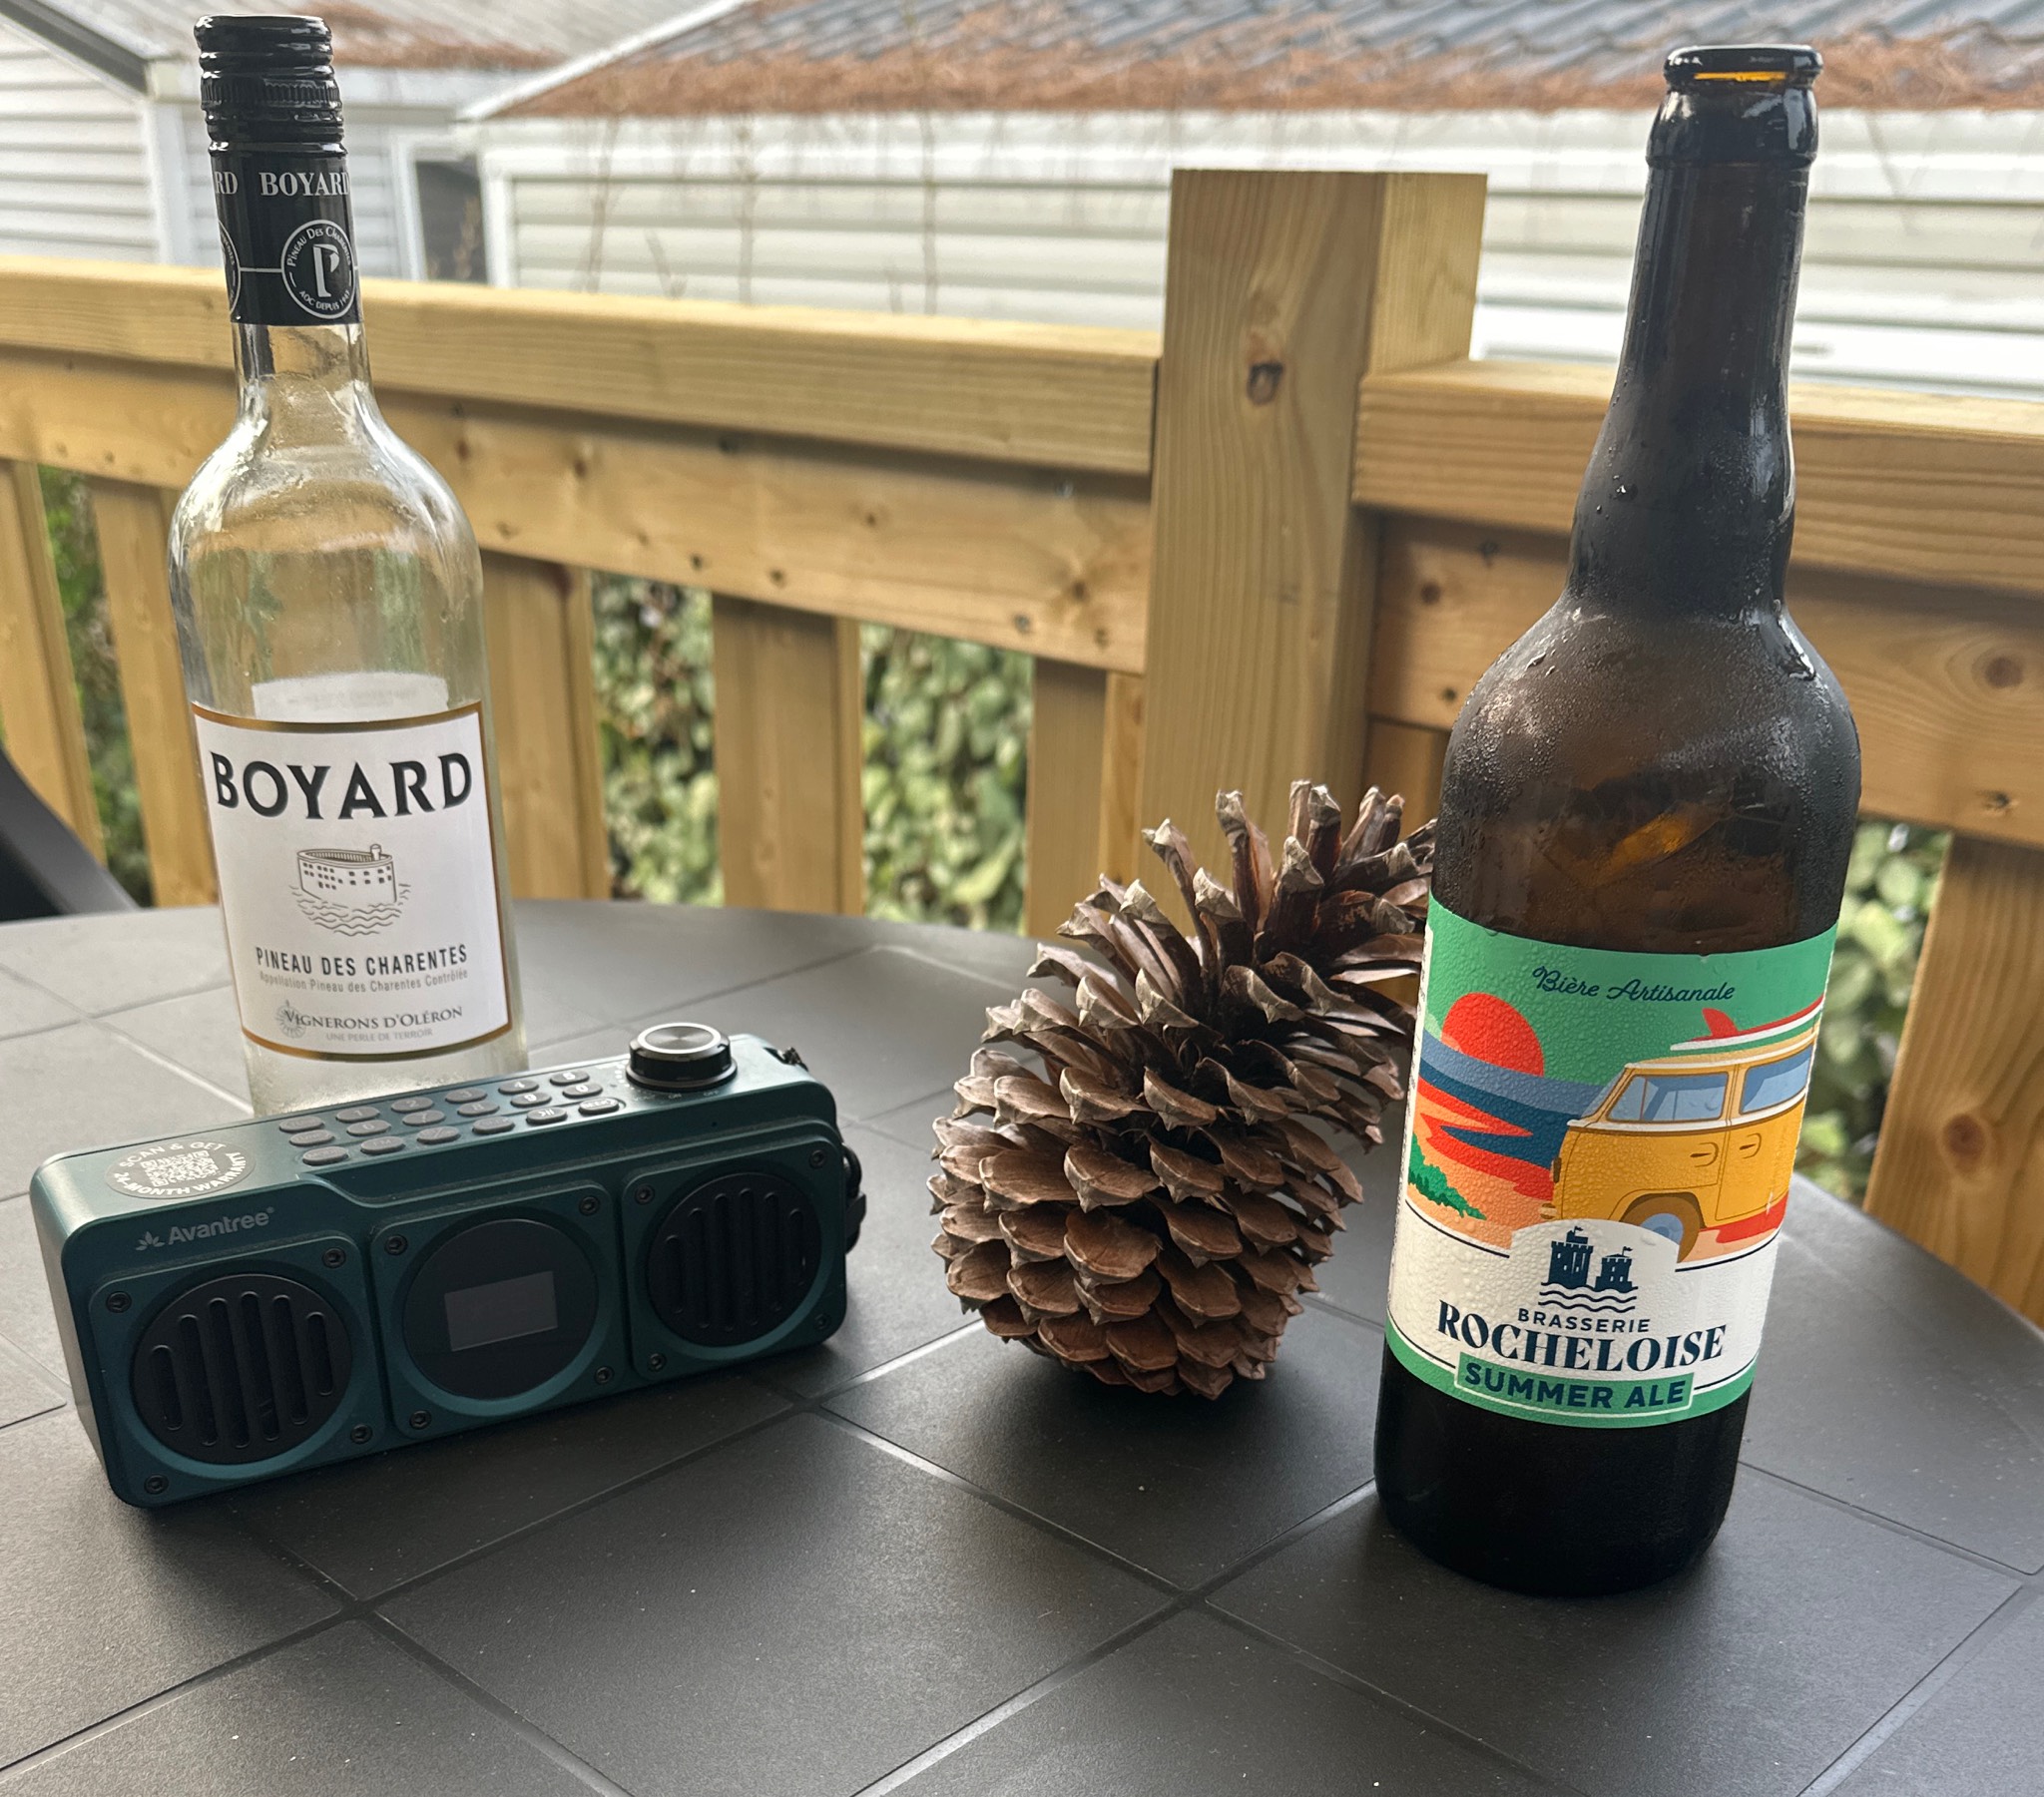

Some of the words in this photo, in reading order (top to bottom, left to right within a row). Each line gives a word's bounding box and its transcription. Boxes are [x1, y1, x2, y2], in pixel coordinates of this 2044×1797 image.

[258, 172, 349, 197] BOYARD
[210, 750, 472, 819] BOYARD
[256, 946, 312, 975] PINEAU
[321, 956, 356, 977] DES
[365, 944, 467, 976] CHARENTES
[259, 971, 307, 990] Appellation
[309, 979, 344, 993] Pineau
[347, 981, 366, 993] des
[370, 978, 422, 993] Charentes
[424, 967, 468, 987] Contrôlée
[1532, 965, 1601, 998] Bière
[1606, 978, 1737, 1003] Artisanale
[326, 1033, 346, 1042] UNE
[347, 1032, 375, 1043] PERLE
[378, 1032, 391, 1042] DE
[394, 1028, 433, 1039] TERROIR
[119, 1145, 166, 1168] SCAN
[190, 1141, 228, 1151] GET
[193, 1151, 247, 1191] WARRANTY
[1437, 1299, 1727, 1372] ROCHELOISE
[1517, 1307, 1651, 1334] BRASSERIE
[1464, 1362, 1614, 1410] SUMMER
[1624, 1380, 1688, 1409] ALE
